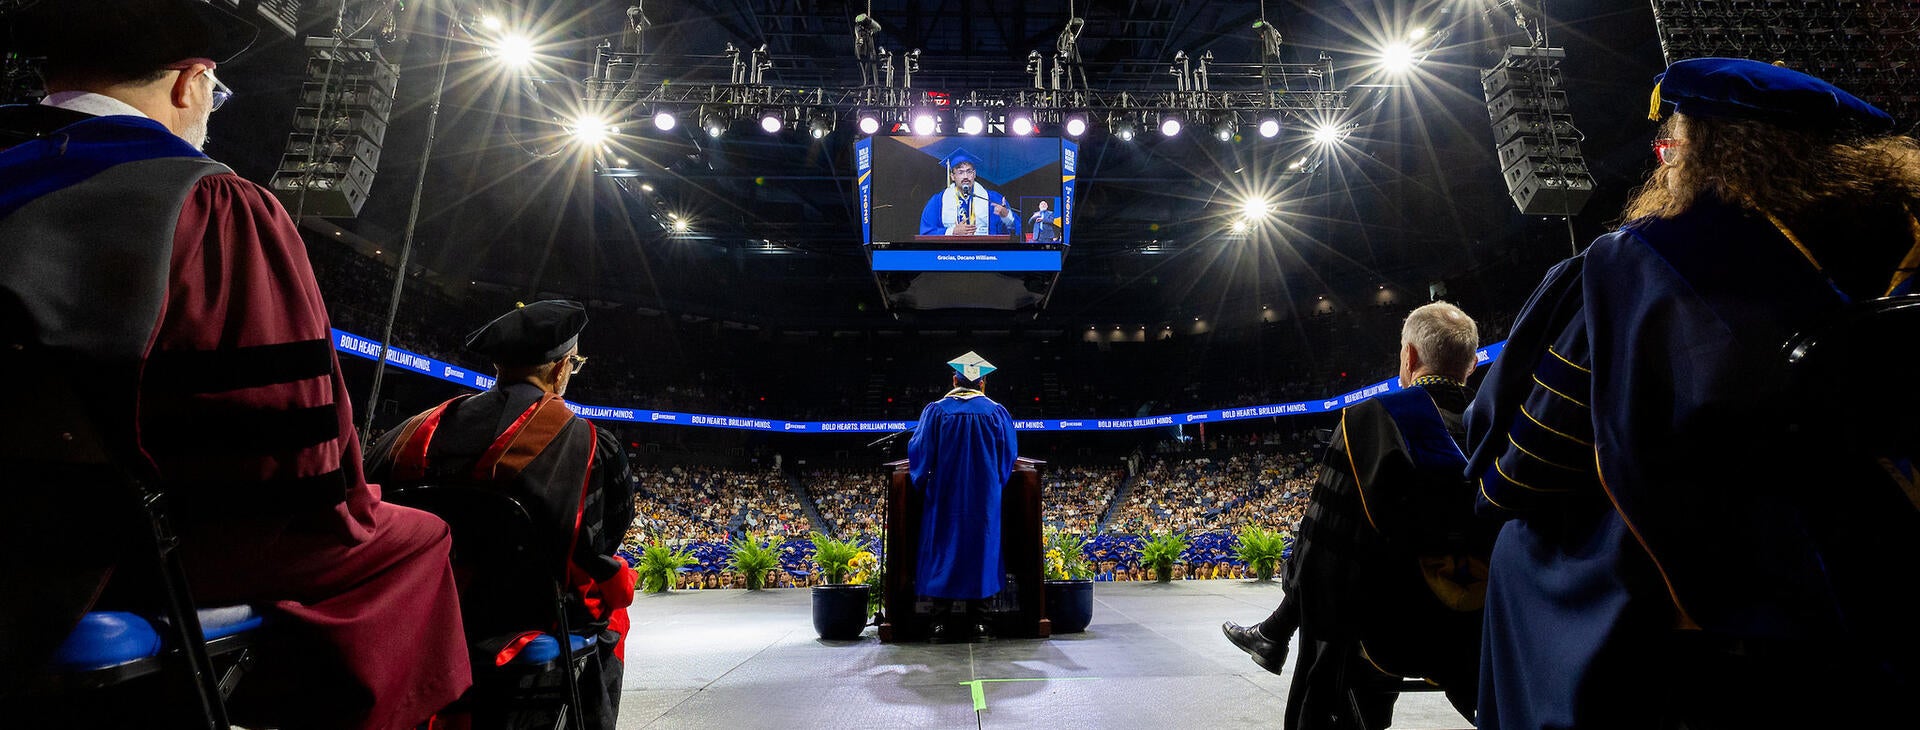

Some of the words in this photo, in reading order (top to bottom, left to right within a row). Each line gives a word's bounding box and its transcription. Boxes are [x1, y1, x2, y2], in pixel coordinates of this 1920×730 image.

[340, 335, 358, 351] BOLD
[412, 356, 431, 372] MINDS.
[582, 407, 613, 418] BRILLIANT
[613, 410, 635, 419] MINDS.
[1222, 410, 1236, 419] BOLD
[1236, 408, 1259, 417] HEARTS.
[1258, 405, 1286, 415] BRILLIANT
[1286, 403, 1308, 413] MINDS.
[691, 416, 706, 424] BOLD
[706, 417, 728, 426] HEARTS.
[728, 419, 754, 428] BRILLIANT
[754, 420, 772, 429] MINDS.
[821, 423, 836, 431] BOLD
[836, 423, 860, 431] HEARTS.
[860, 423, 887, 431] BRILLIANT
[887, 422, 907, 430] MINDS.
[1025, 421, 1045, 429] MINDS.
[1098, 420, 1112, 428] BOLD
[1112, 420, 1133, 428] HEARTS.
[1133, 418, 1156, 427] BRILLIANT
[1156, 416, 1173, 425] MINDS.
